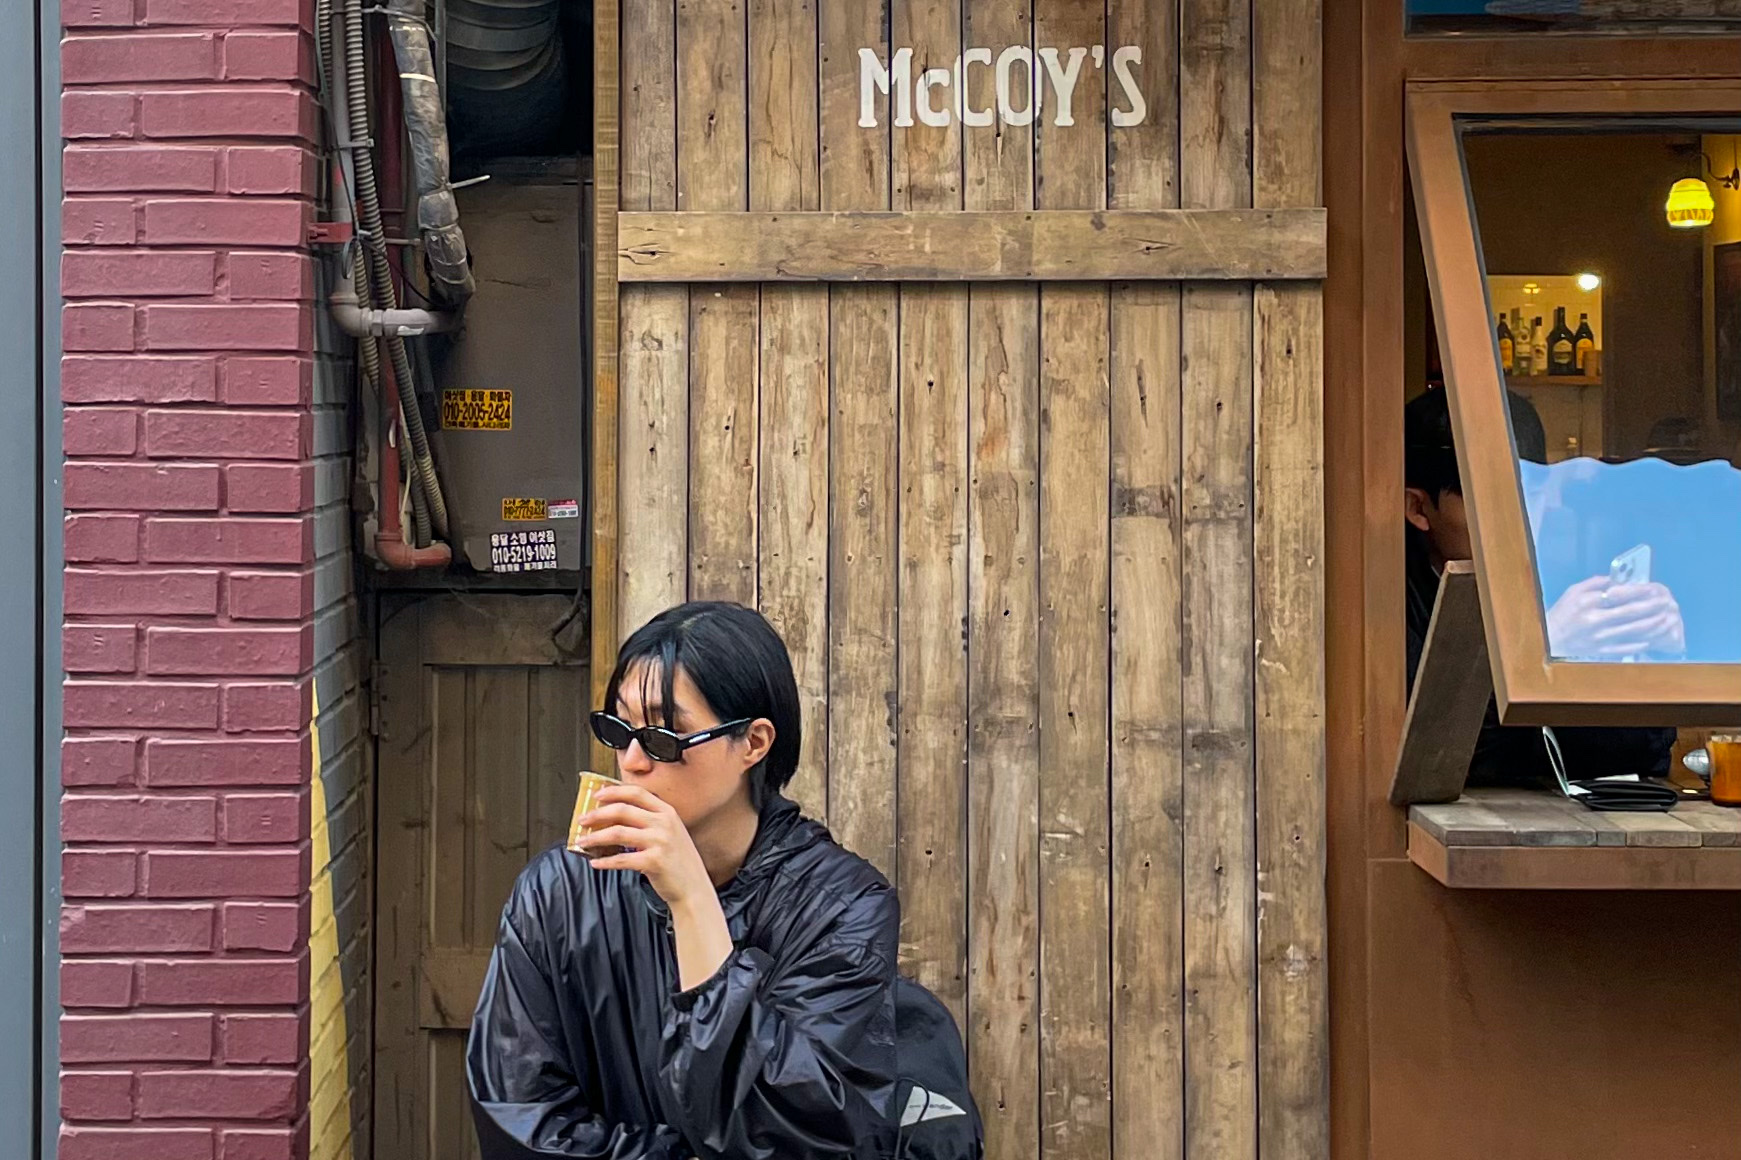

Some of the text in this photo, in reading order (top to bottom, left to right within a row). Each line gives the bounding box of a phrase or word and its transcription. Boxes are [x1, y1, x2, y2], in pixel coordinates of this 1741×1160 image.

[858, 45, 1147, 128] McCOY'S
[444, 401, 511, 421] 010-2005-2424
[529, 529, 555, 543] 이삿짐
[492, 543, 556, 564] 010-5219-1009
